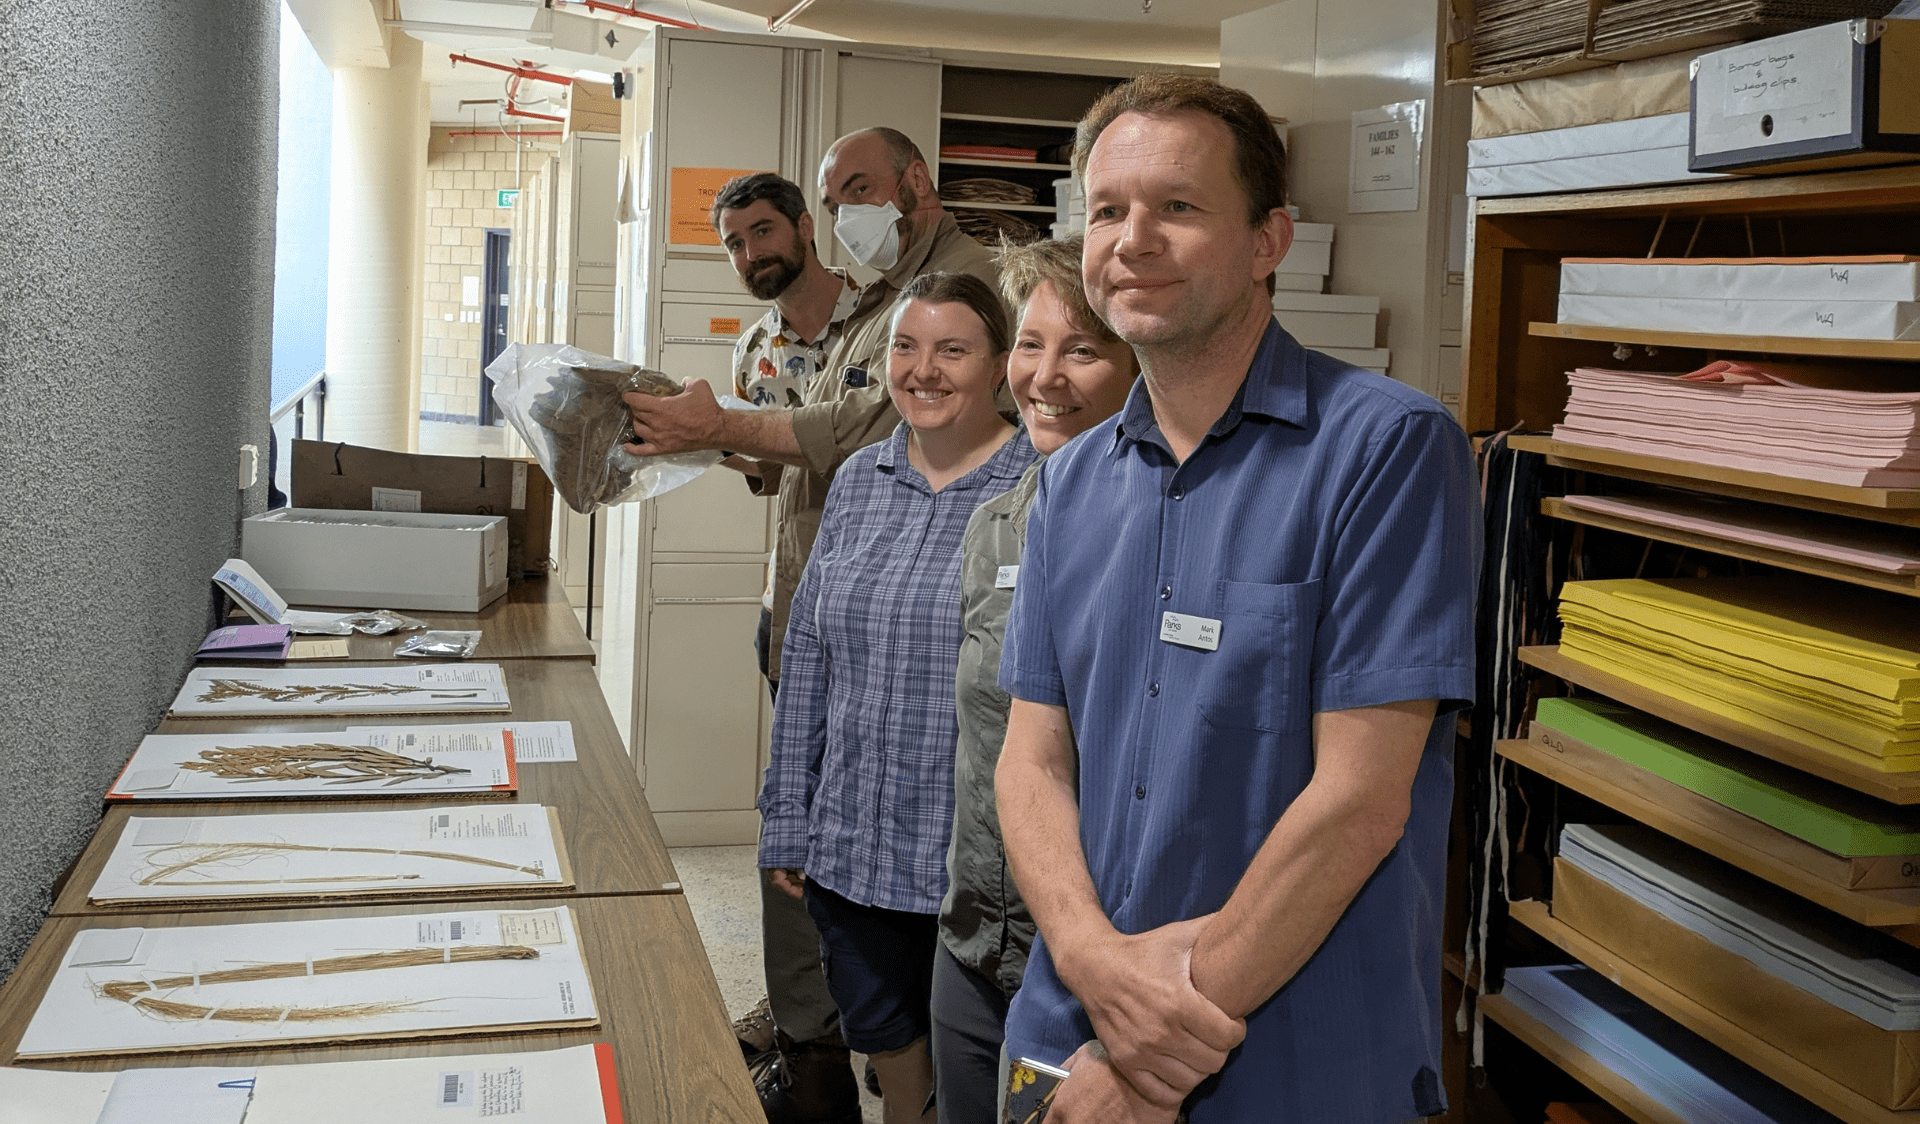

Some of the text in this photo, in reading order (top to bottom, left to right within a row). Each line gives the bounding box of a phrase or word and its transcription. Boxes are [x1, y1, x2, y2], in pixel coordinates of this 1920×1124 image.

[1768, 53, 1795, 68] bags
[1368, 129, 1399, 142] FAMILIES
[1830, 267, 1849, 284] WA
[1815, 311, 1834, 328] WA
[1164, 618, 1182, 631] Parks
[1201, 624, 1215, 634] Mark
[1198, 634, 1214, 644] Antos
